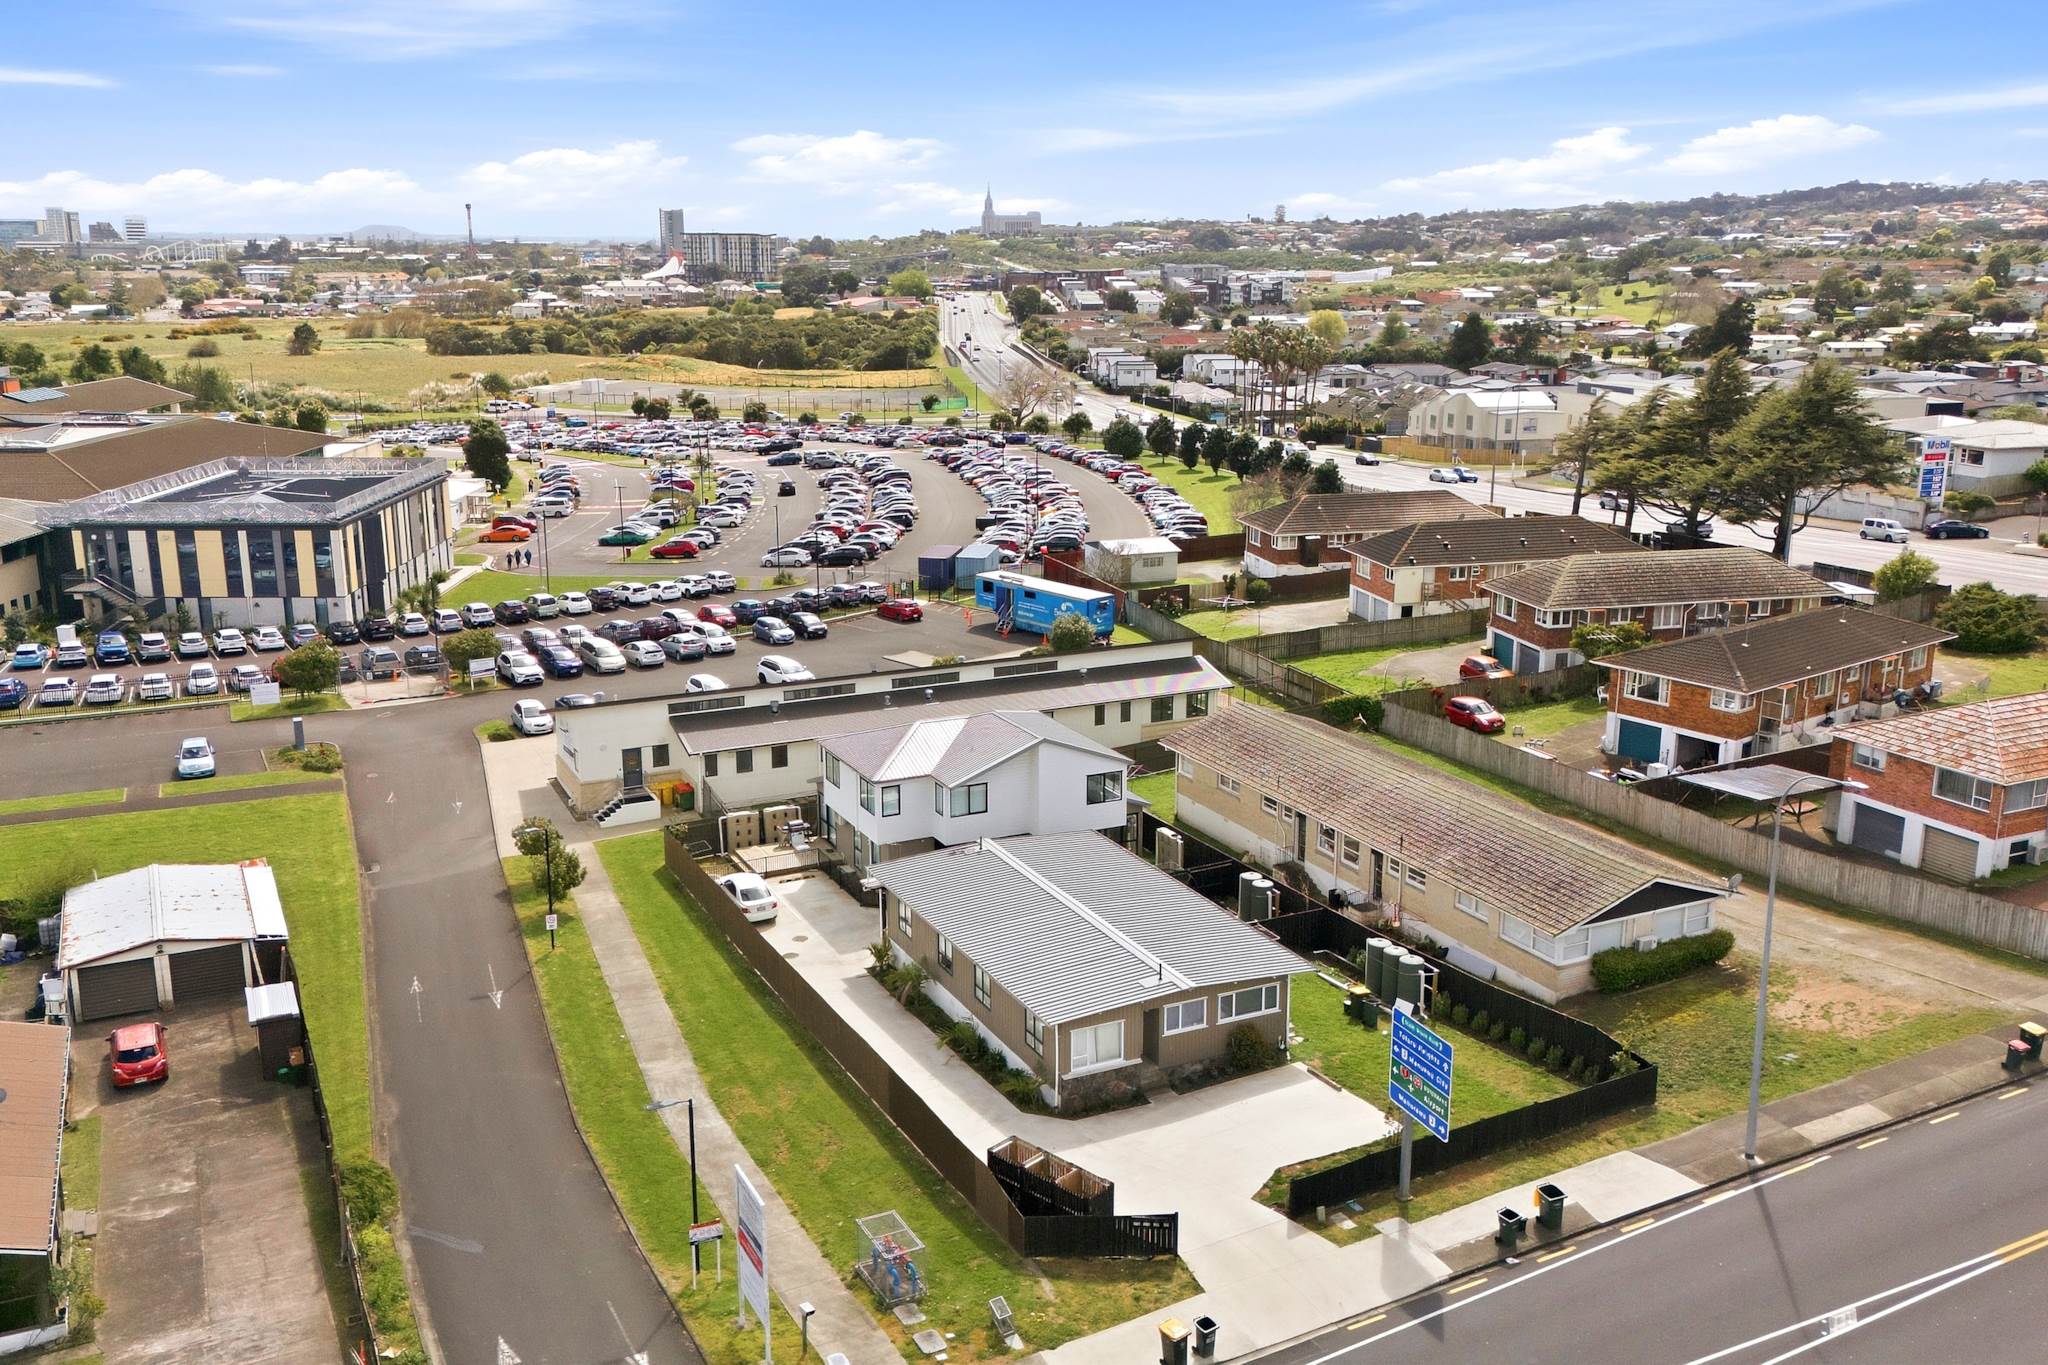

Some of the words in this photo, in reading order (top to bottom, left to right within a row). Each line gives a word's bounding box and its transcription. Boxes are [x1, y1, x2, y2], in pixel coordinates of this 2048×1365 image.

[1927, 440, 1950, 449] Mobil
[1436, 1075, 1449, 1090] City
[1423, 1095, 1444, 1116] Airport
